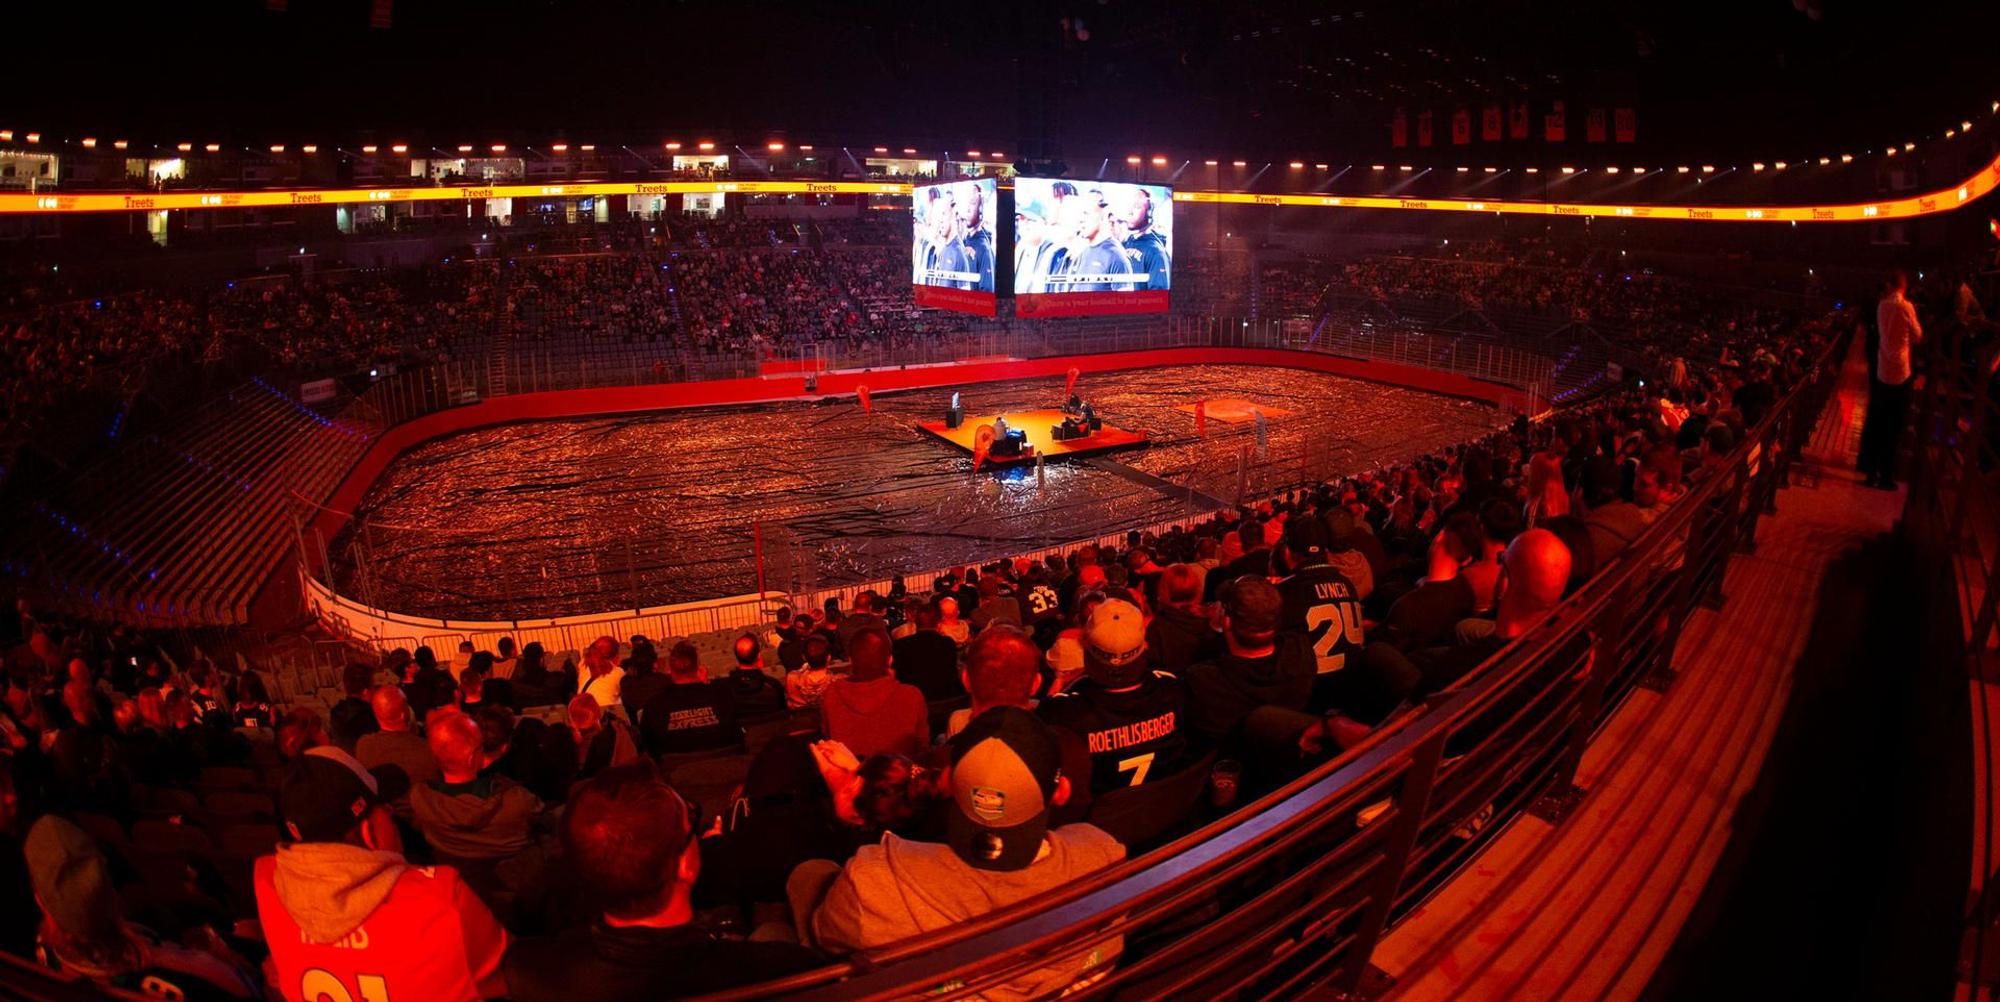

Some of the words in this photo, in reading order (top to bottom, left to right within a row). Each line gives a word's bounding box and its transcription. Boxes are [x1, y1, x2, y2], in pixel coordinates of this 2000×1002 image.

[461, 188, 494, 198] Treets
[635, 184, 668, 193] Treets
[806, 183, 838, 192] Treets
[124, 196, 154, 208] Treets
[290, 192, 322, 204] Treets
[1254, 195, 1282, 203] Treets
[1400, 199, 1428, 208] Treets
[1553, 205, 1580, 215] Treets
[1688, 208, 1713, 219] Treets
[1314, 582, 1350, 599] LYNCH
[1028, 589, 1059, 614] 33
[1306, 601, 1364, 675] 24
[667, 715, 720, 731] EXPRESS
[1088, 711, 1175, 753] ROETHLISBERGER
[1118, 752, 1155, 787] 7
